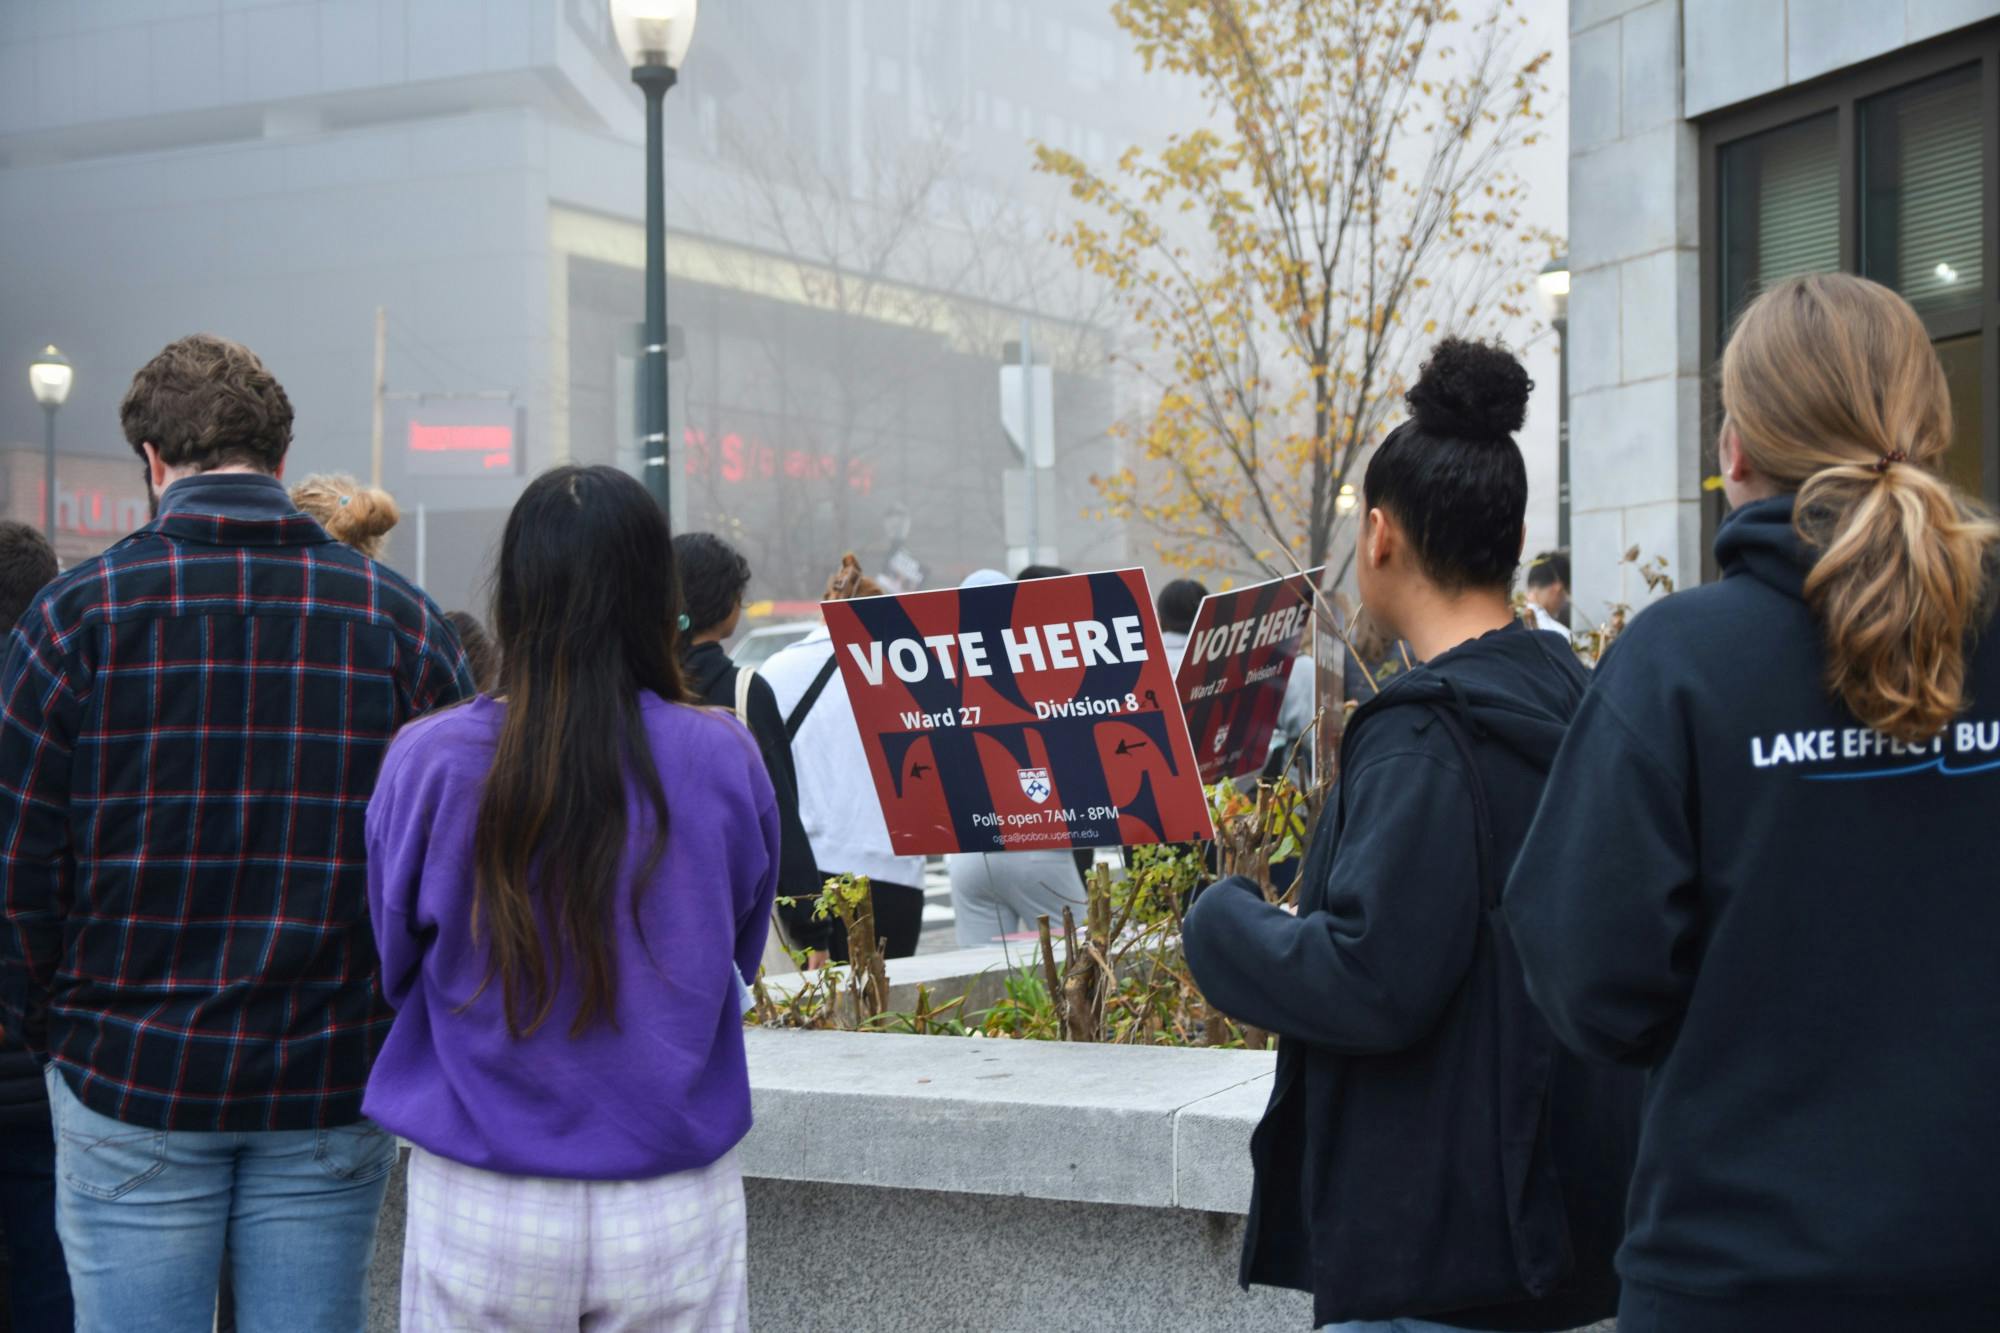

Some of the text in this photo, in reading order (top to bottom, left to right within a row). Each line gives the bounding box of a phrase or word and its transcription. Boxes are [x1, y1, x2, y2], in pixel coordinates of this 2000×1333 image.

[1192, 604, 1306, 666] VOTE HERE
[847, 615, 1149, 686] VOTE HERE
[1190, 678, 1229, 701] Ward 27
[900, 706, 982, 730] Ward 27
[1034, 693, 1139, 720] Division 8
[1751, 730, 1836, 768] LAKE
[1955, 721, 2000, 752] BU
[972, 812, 1005, 827] Polls
[1007, 812, 1042, 828] open
[1044, 809, 1076, 825] 7AM
[1087, 806, 1120, 821] 8PM
